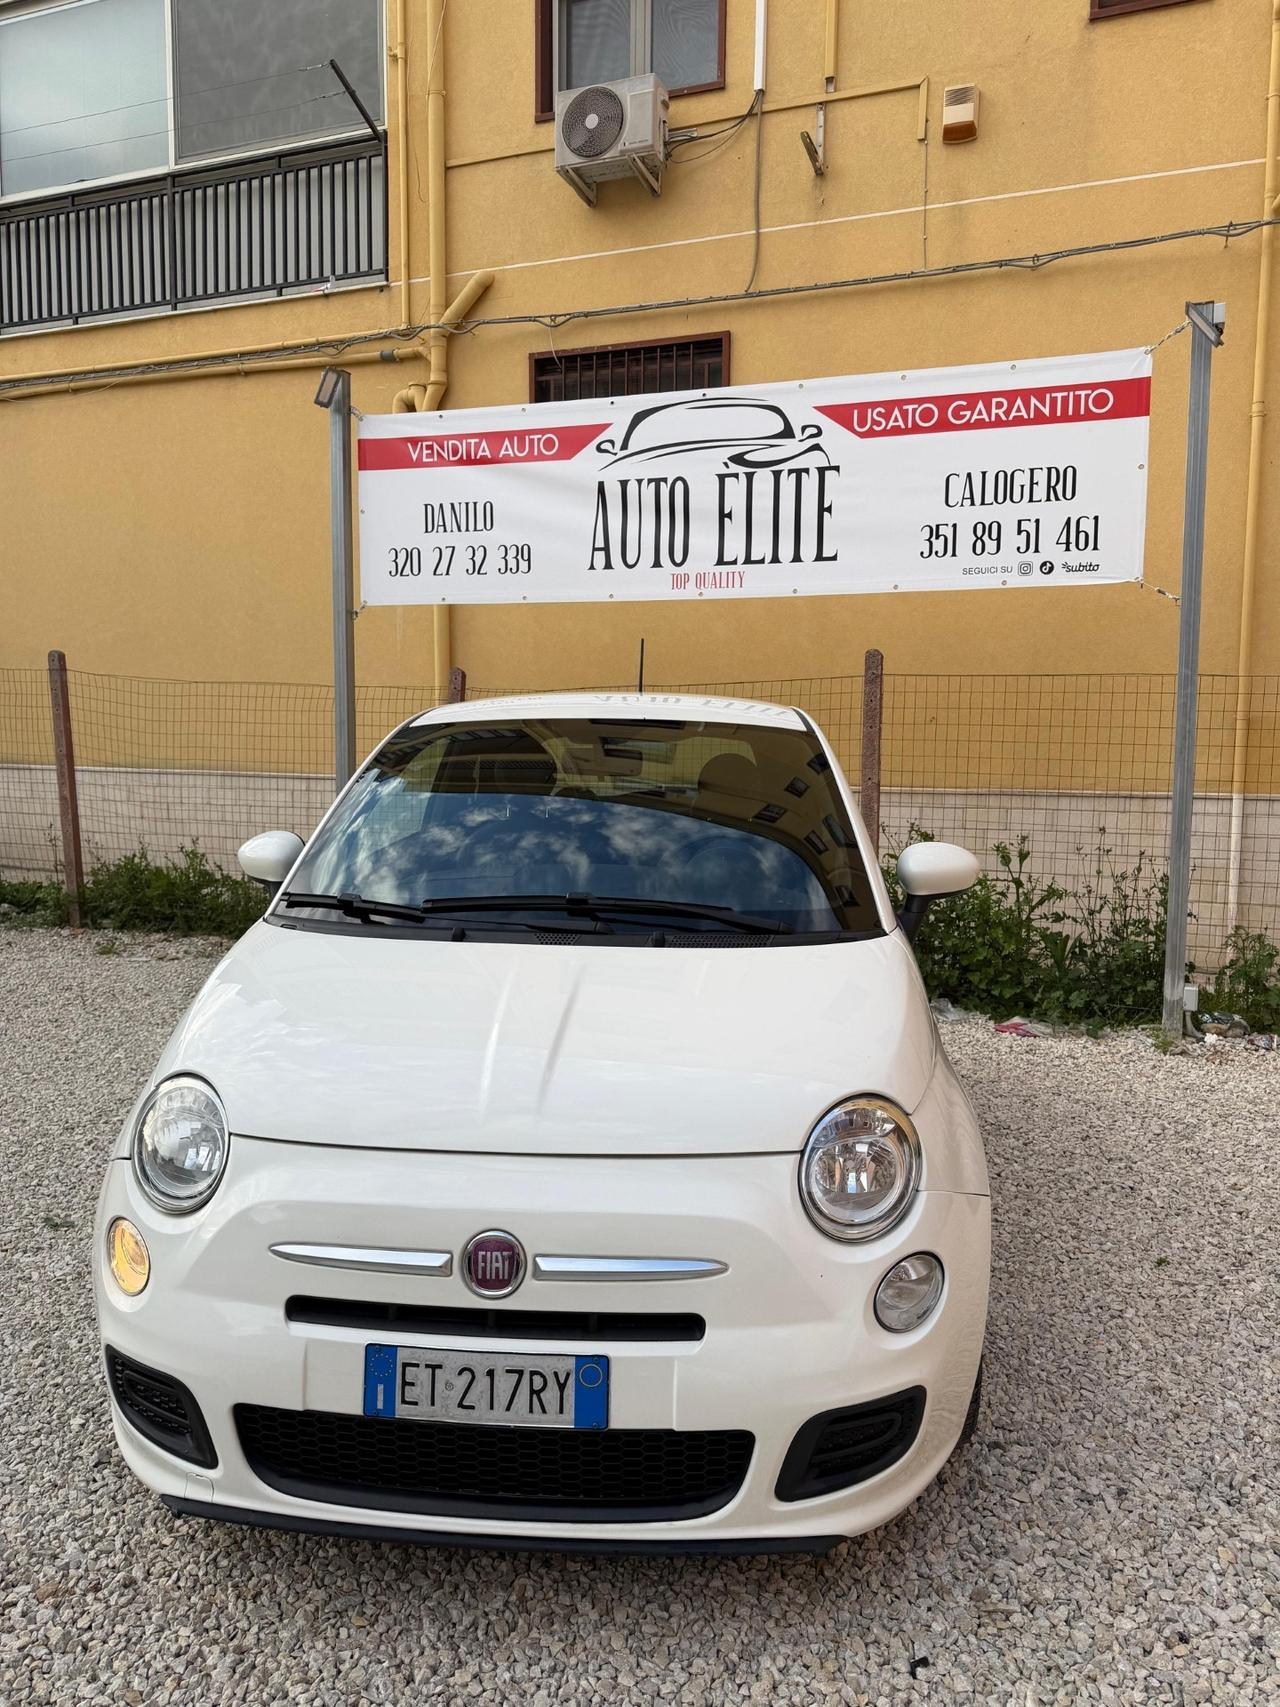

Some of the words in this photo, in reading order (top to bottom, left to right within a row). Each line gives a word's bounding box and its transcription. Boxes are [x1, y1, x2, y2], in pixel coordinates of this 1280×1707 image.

[853, 403, 939, 433] USATO
[948, 387, 1114, 425] GARANTITO
[407, 438, 492, 463] VENDITA
[498, 433, 560, 458] AUTO
[944, 465, 1077, 509] CALOGERO
[423, 501, 494, 534] DANILO
[587, 475, 690, 571] AUTO
[713, 461, 841, 567] ÈLITE
[920, 522, 958, 559] 351
[971, 520, 1001, 557] 89
[1016, 518, 1041, 554] 51
[1055, 515, 1100, 552] 461
[388, 546, 421, 578] 320
[432, 545, 456, 577] 27
[465, 544, 488, 576] 32
[497, 543, 532, 575] 339
[962, 566, 998, 576] SEGUICI
[1000, 565, 1013, 574] SU
[1062, 561, 1100, 573] subito
[670, 572, 690, 591] TOP
[694, 571, 746, 590] QUALITY
[477, 1250, 514, 1280] FIAT
[400, 1362, 443, 1407] ET
[456, 1367, 571, 1415] 217RY
